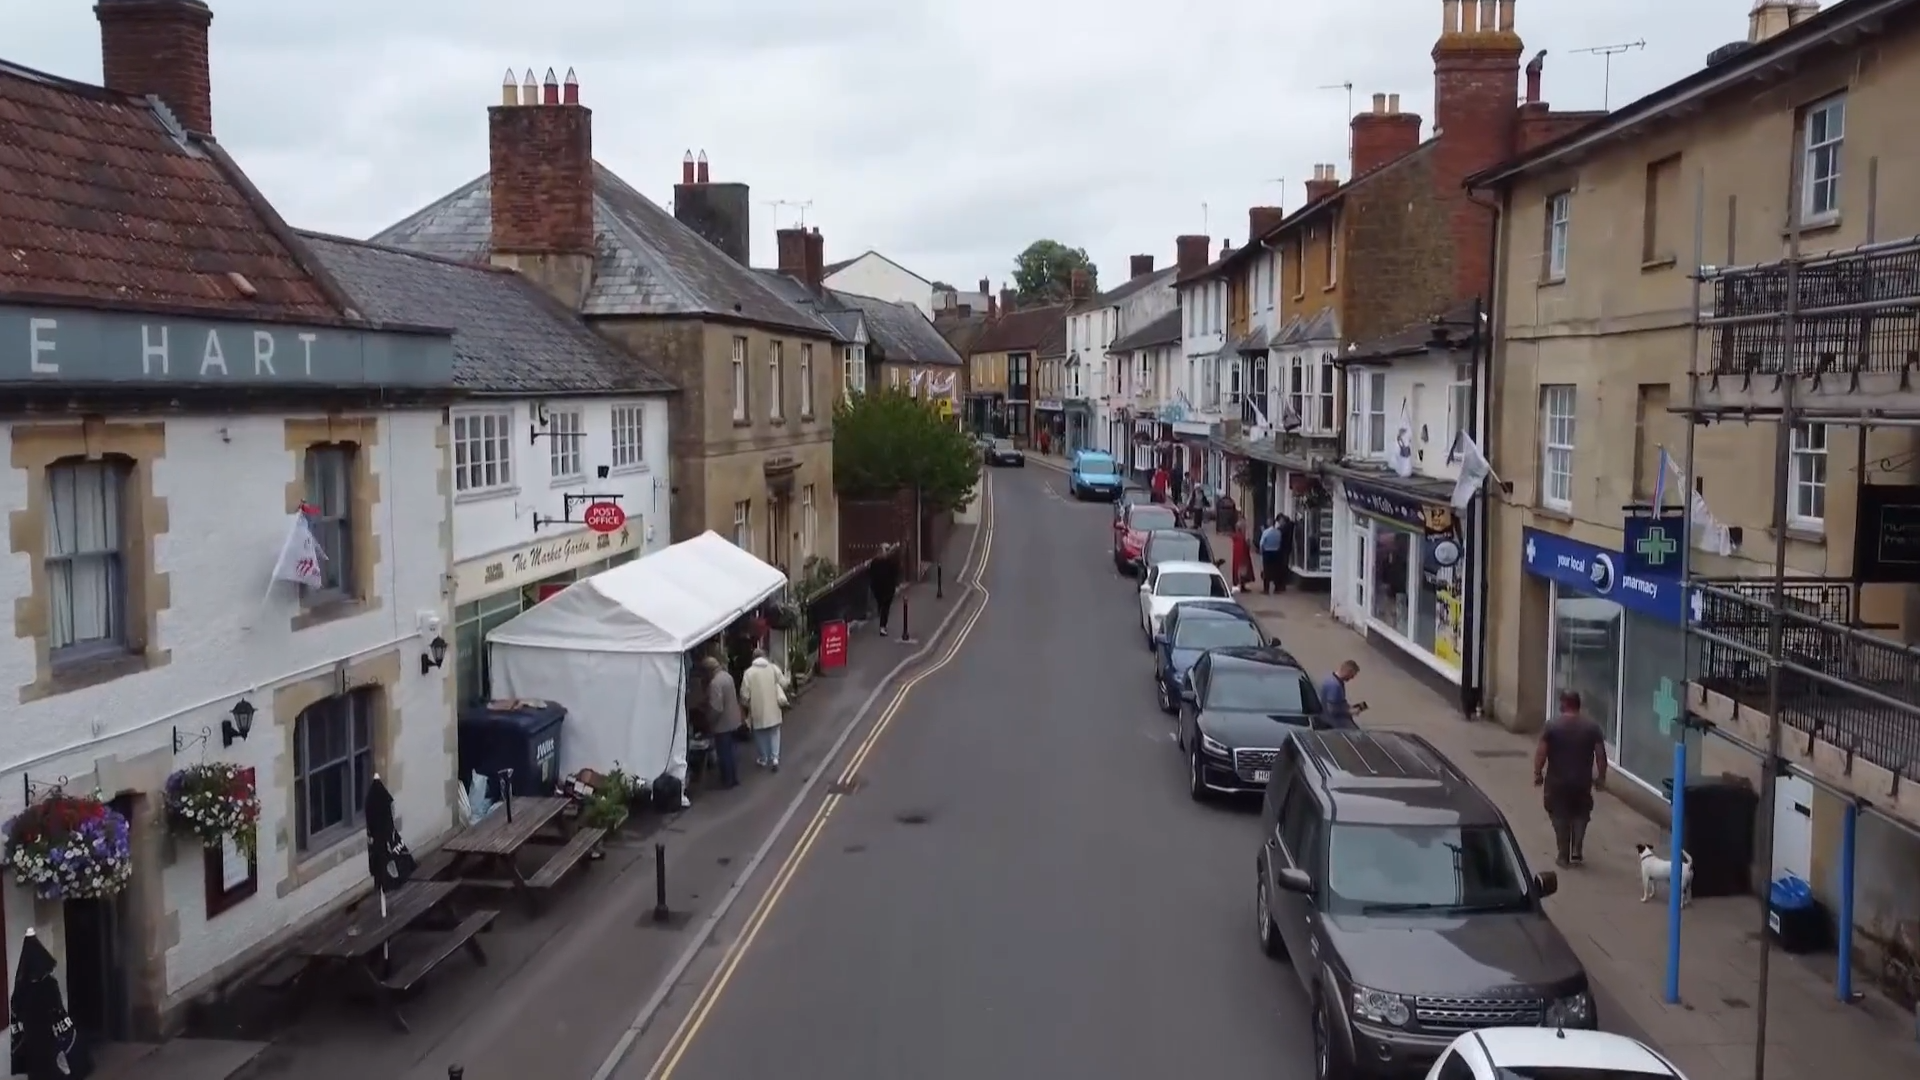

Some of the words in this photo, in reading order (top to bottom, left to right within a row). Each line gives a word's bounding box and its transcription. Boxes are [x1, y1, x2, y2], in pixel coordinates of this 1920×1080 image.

[141, 324, 318, 376] HART
[588, 515, 619, 526] OFFICE
[593, 507, 615, 516] POST
[512, 552, 528, 573] The
[529, 544, 562, 567] Market
[563, 538, 591, 563] Garden
[1557, 554, 1571, 572] your
[1570, 556, 1585, 573] local
